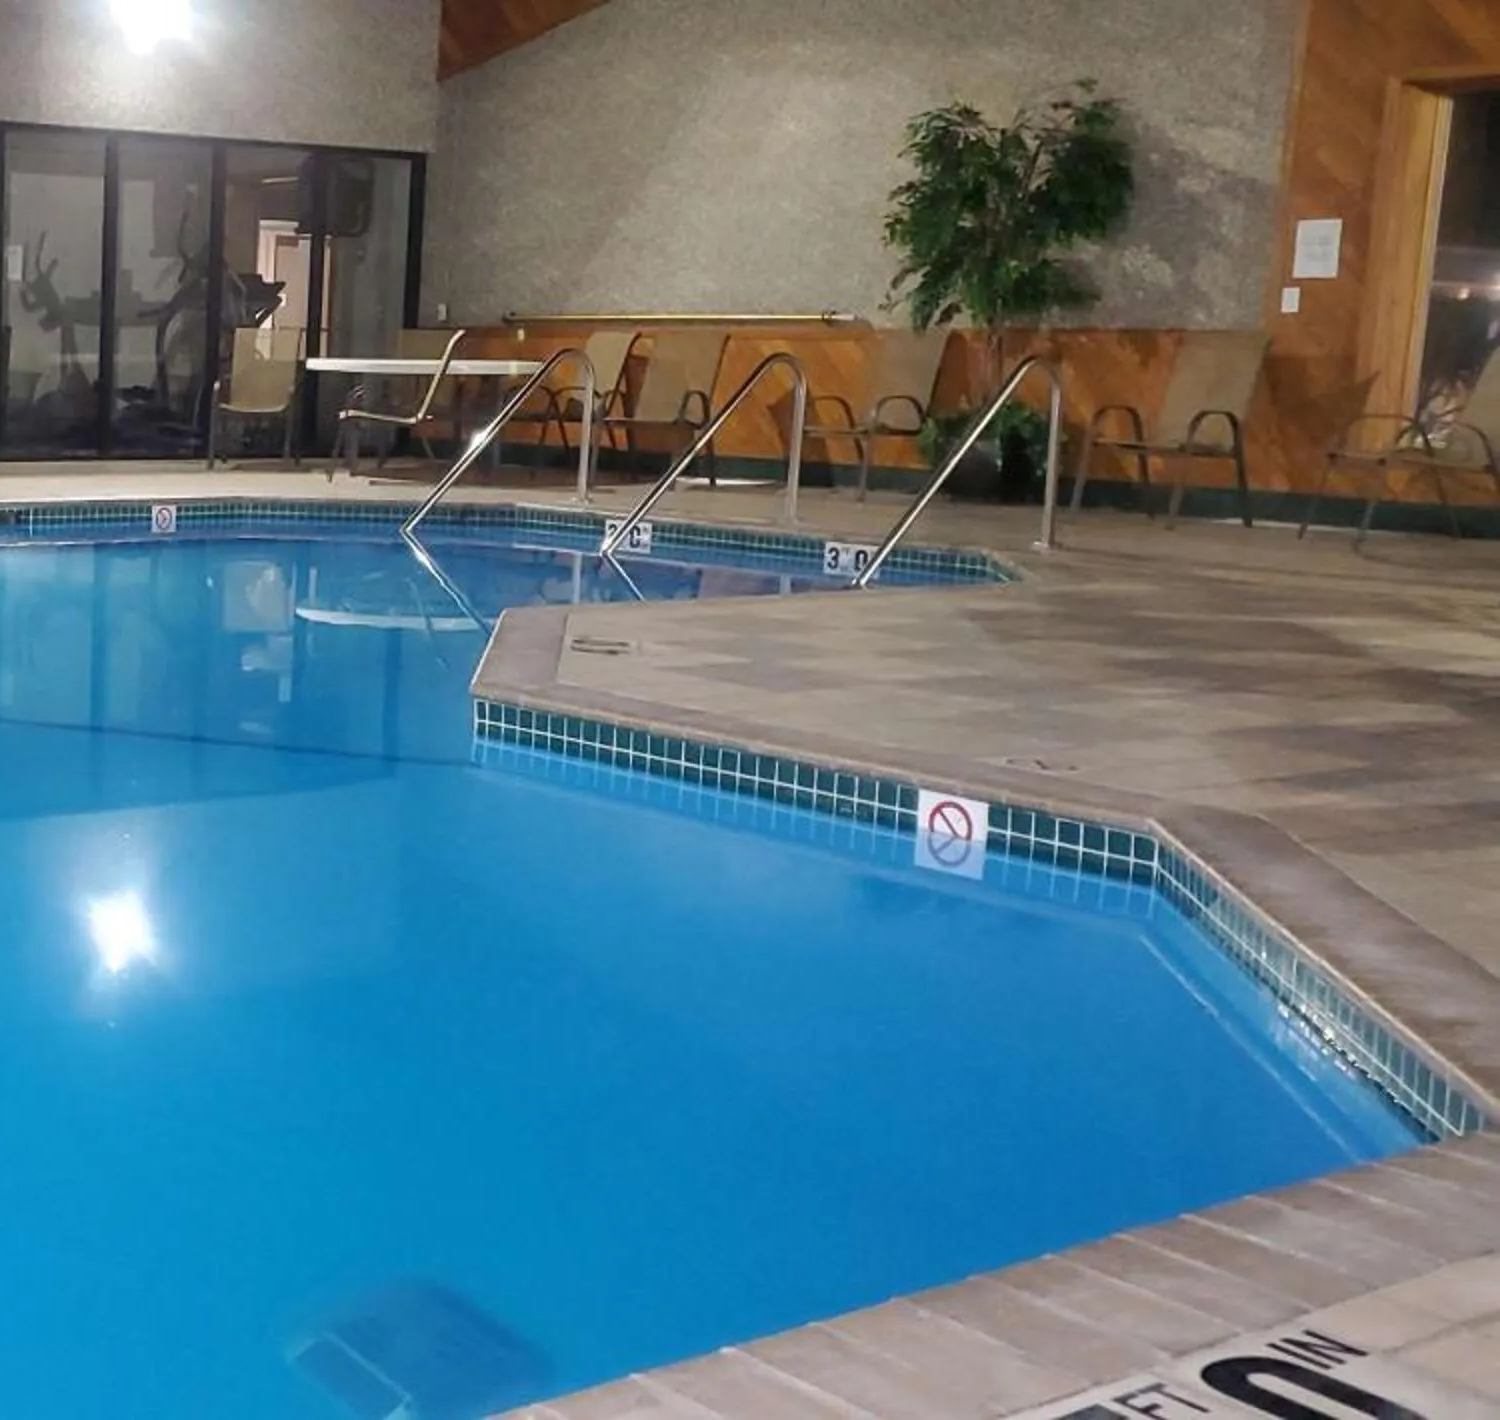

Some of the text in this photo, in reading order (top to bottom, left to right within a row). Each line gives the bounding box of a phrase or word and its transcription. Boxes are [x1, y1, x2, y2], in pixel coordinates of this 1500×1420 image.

[828, 547, 840, 569] 3
[855, 550, 869, 571] 0
[1111, 1382, 1211, 1420] FT
[1266, 1329, 1370, 1370] IN
